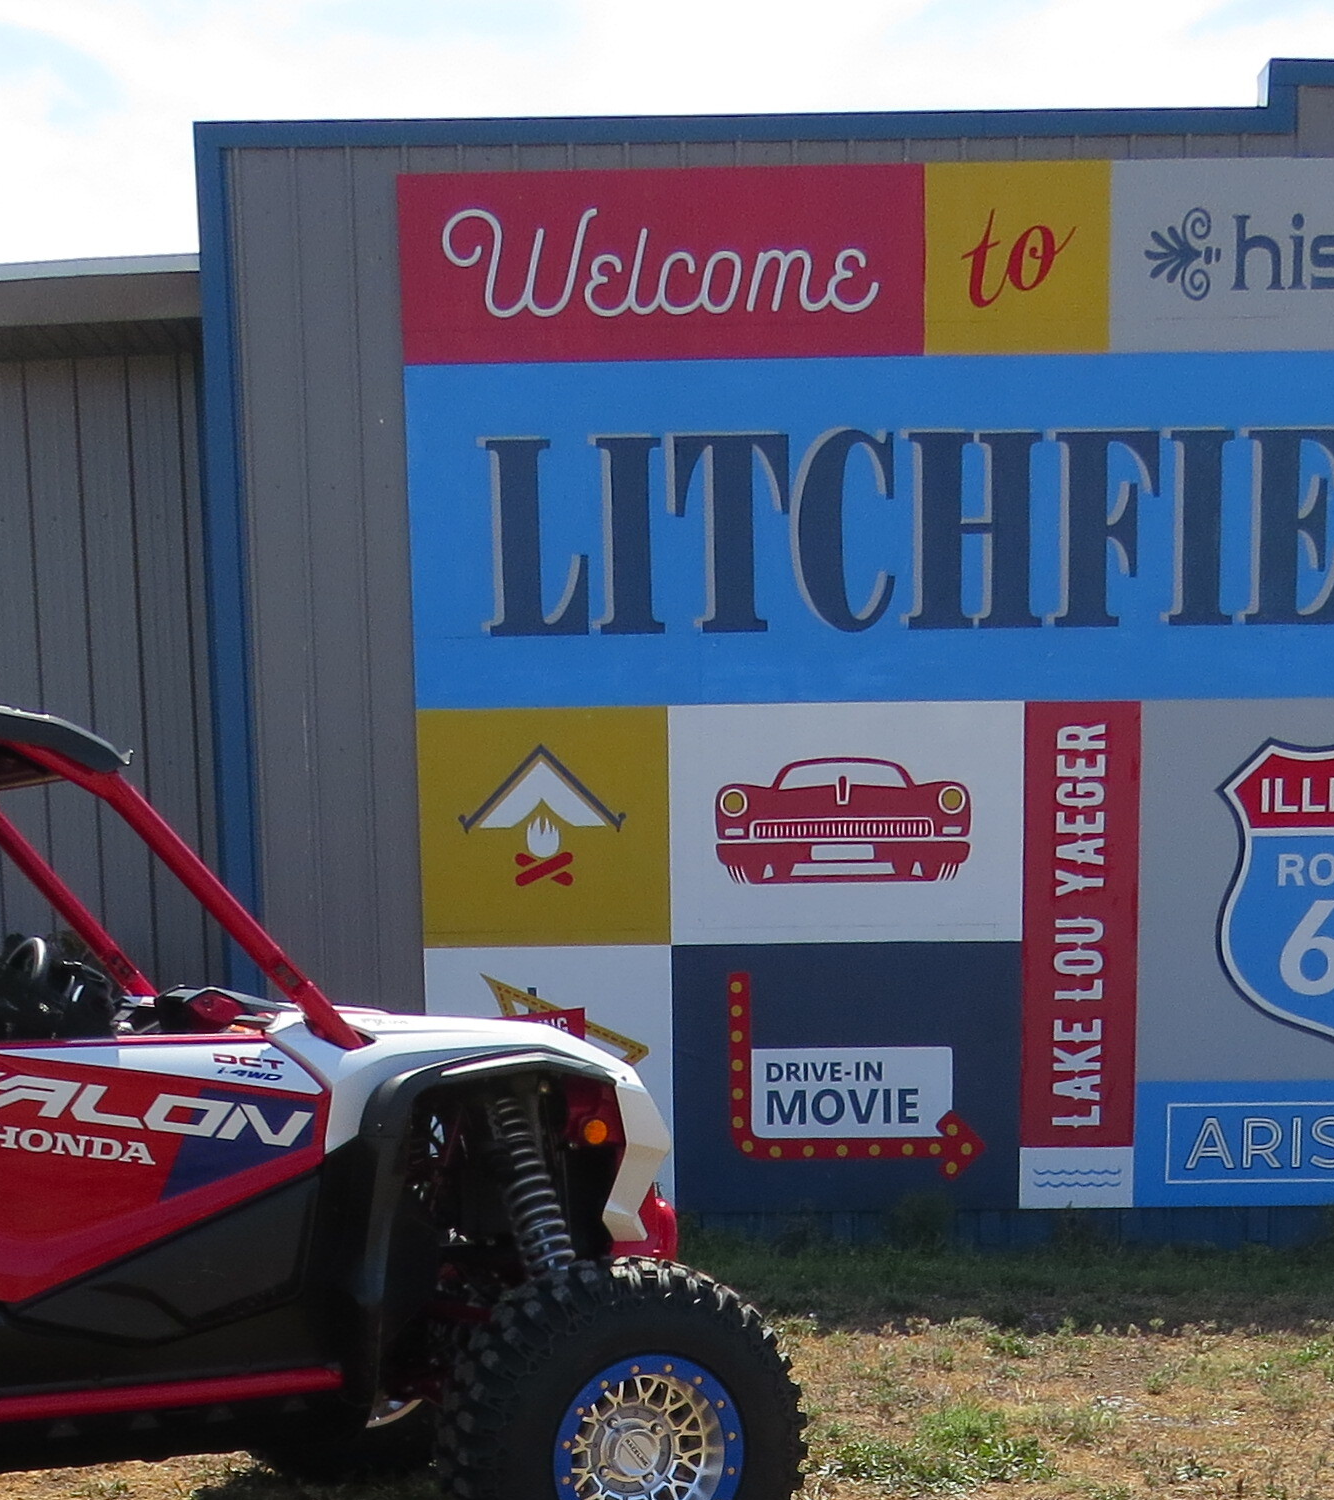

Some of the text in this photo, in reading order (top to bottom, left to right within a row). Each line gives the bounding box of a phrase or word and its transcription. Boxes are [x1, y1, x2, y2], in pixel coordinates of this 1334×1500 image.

[442, 207, 880, 318] Welcome
[961, 208, 1077, 308] to
[1051, 723, 1108, 1128] LAKE LOU YAEGER
[213, 1053, 285, 1070] DCT
[765, 1060, 884, 1084] DRIVE-IN
[765, 1087, 921, 1127] MOVIE
